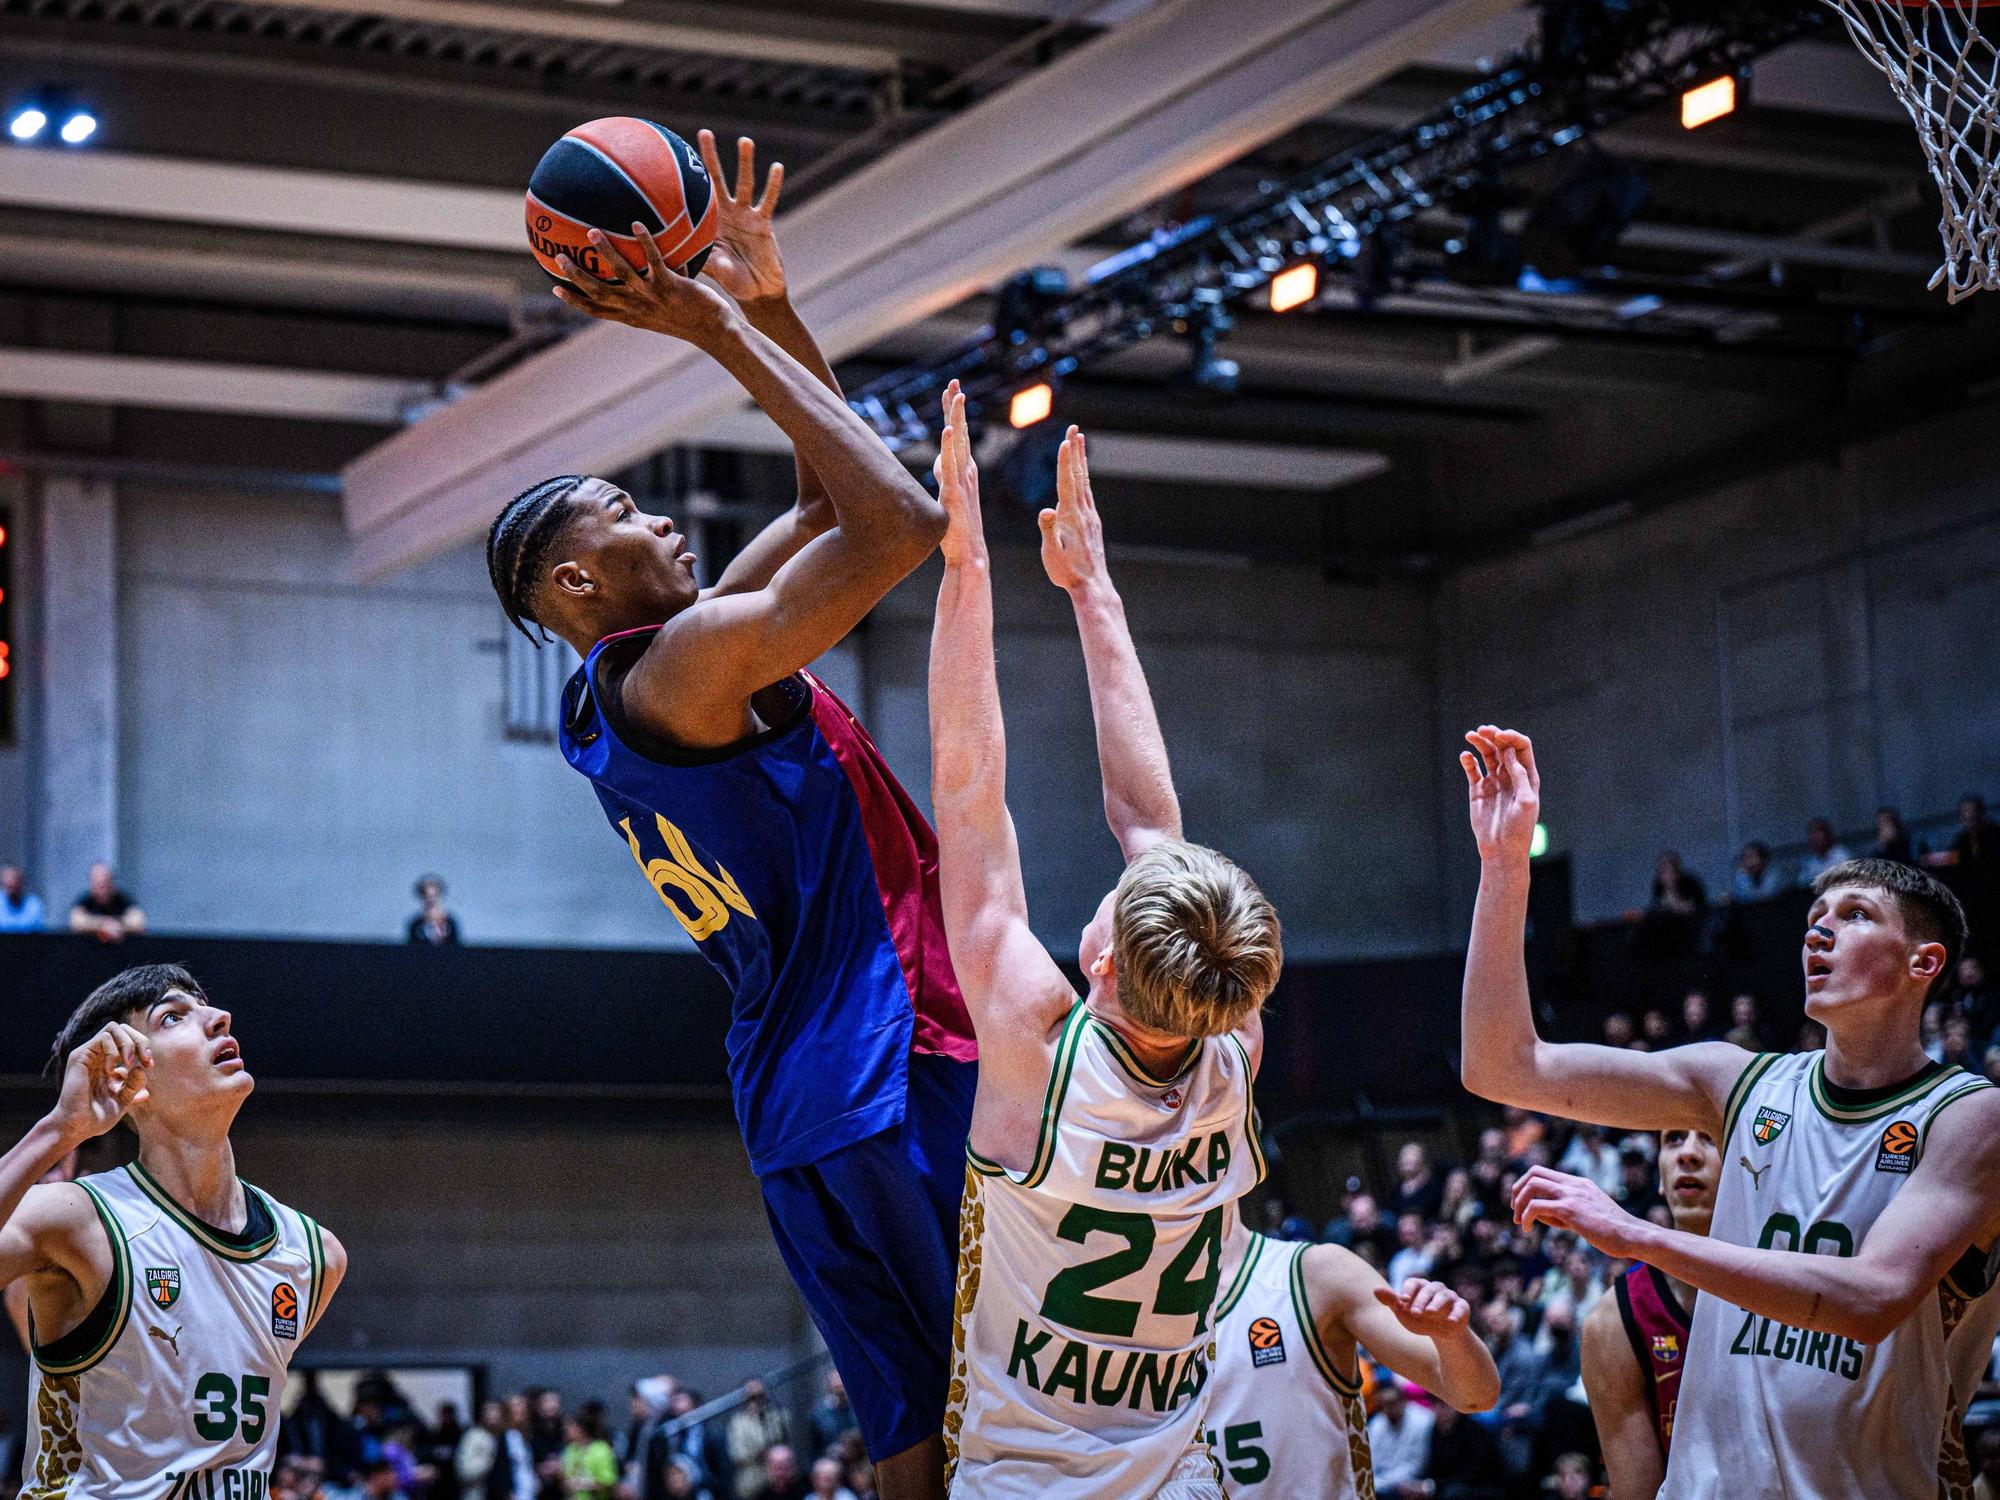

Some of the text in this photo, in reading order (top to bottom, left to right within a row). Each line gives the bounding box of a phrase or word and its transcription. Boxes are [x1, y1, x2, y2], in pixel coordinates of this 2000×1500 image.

[527, 224, 599, 273] ALDING
[1758, 1108, 1788, 1125] ZALGIRIS
[1095, 1130, 1231, 1193] BUIKA
[1879, 1159, 1909, 1167] AIRLINES
[1881, 1153, 1910, 1161] TURKISH
[147, 1269, 179, 1281] ZALGIRIS
[1039, 1203, 1223, 1337] 24
[1729, 1307, 1866, 1381] ZLGIRIS
[193, 1371, 270, 1444] 35
